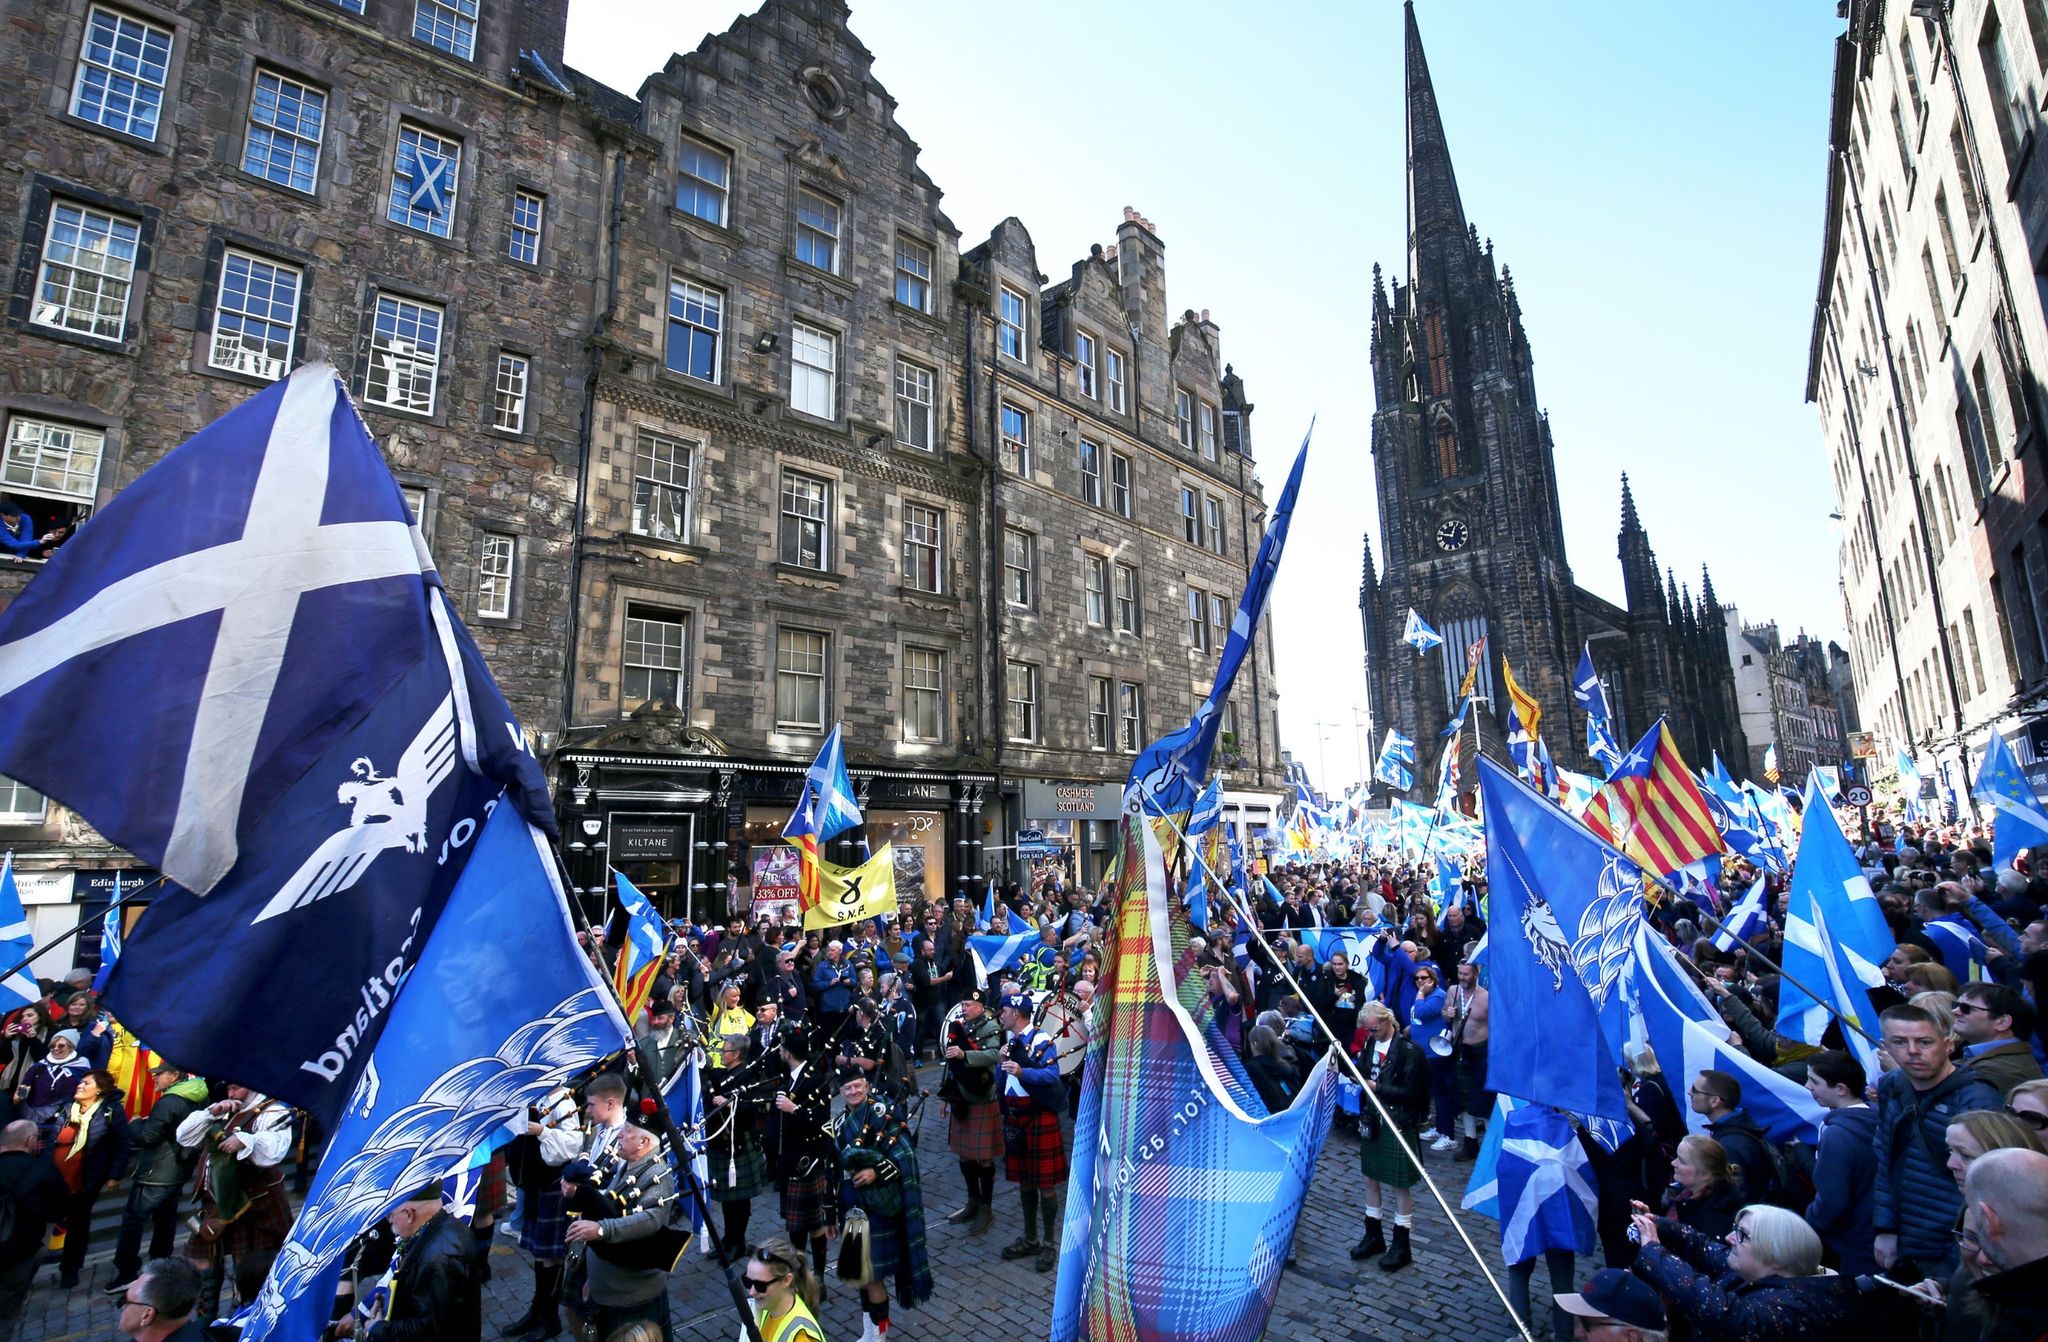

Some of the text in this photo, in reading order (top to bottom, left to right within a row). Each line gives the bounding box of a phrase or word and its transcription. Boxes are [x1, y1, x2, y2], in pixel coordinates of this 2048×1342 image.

[887, 785, 937, 798] KILTANE
[1056, 788, 1094, 799] CASHMERE
[1850, 791, 1869, 801] 20
[1057, 801, 1095, 812] SCOTLAND
[628, 838, 667, 847] KILTANE
[90, 878, 144, 888] Edinurgh
[756, 873, 797, 883] PRINGLE
[755, 887, 797, 900] 33% OFF
